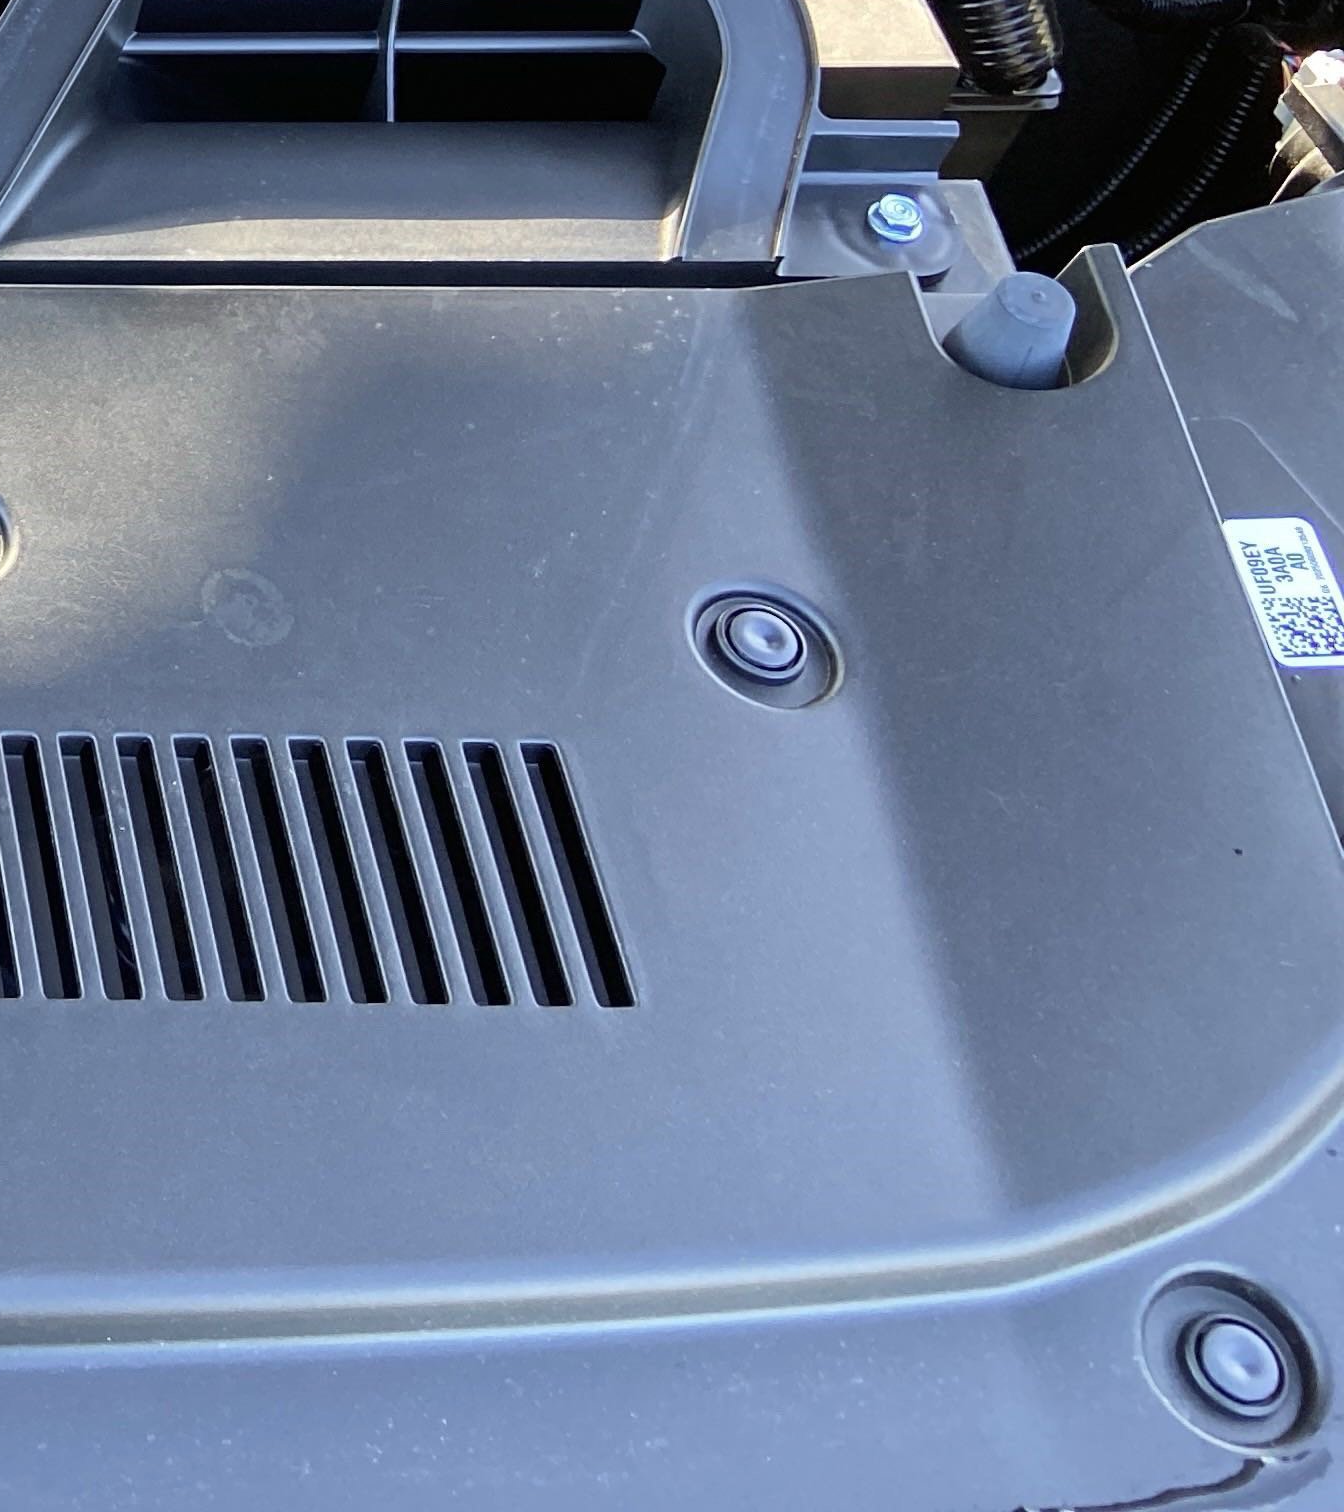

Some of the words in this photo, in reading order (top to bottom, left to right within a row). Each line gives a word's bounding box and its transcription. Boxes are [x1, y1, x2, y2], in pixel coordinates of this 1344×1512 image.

[1239, 541, 1276, 594] UF09EY
[1264, 546, 1293, 583] 3A0A
[1285, 553, 1308, 570] A0
